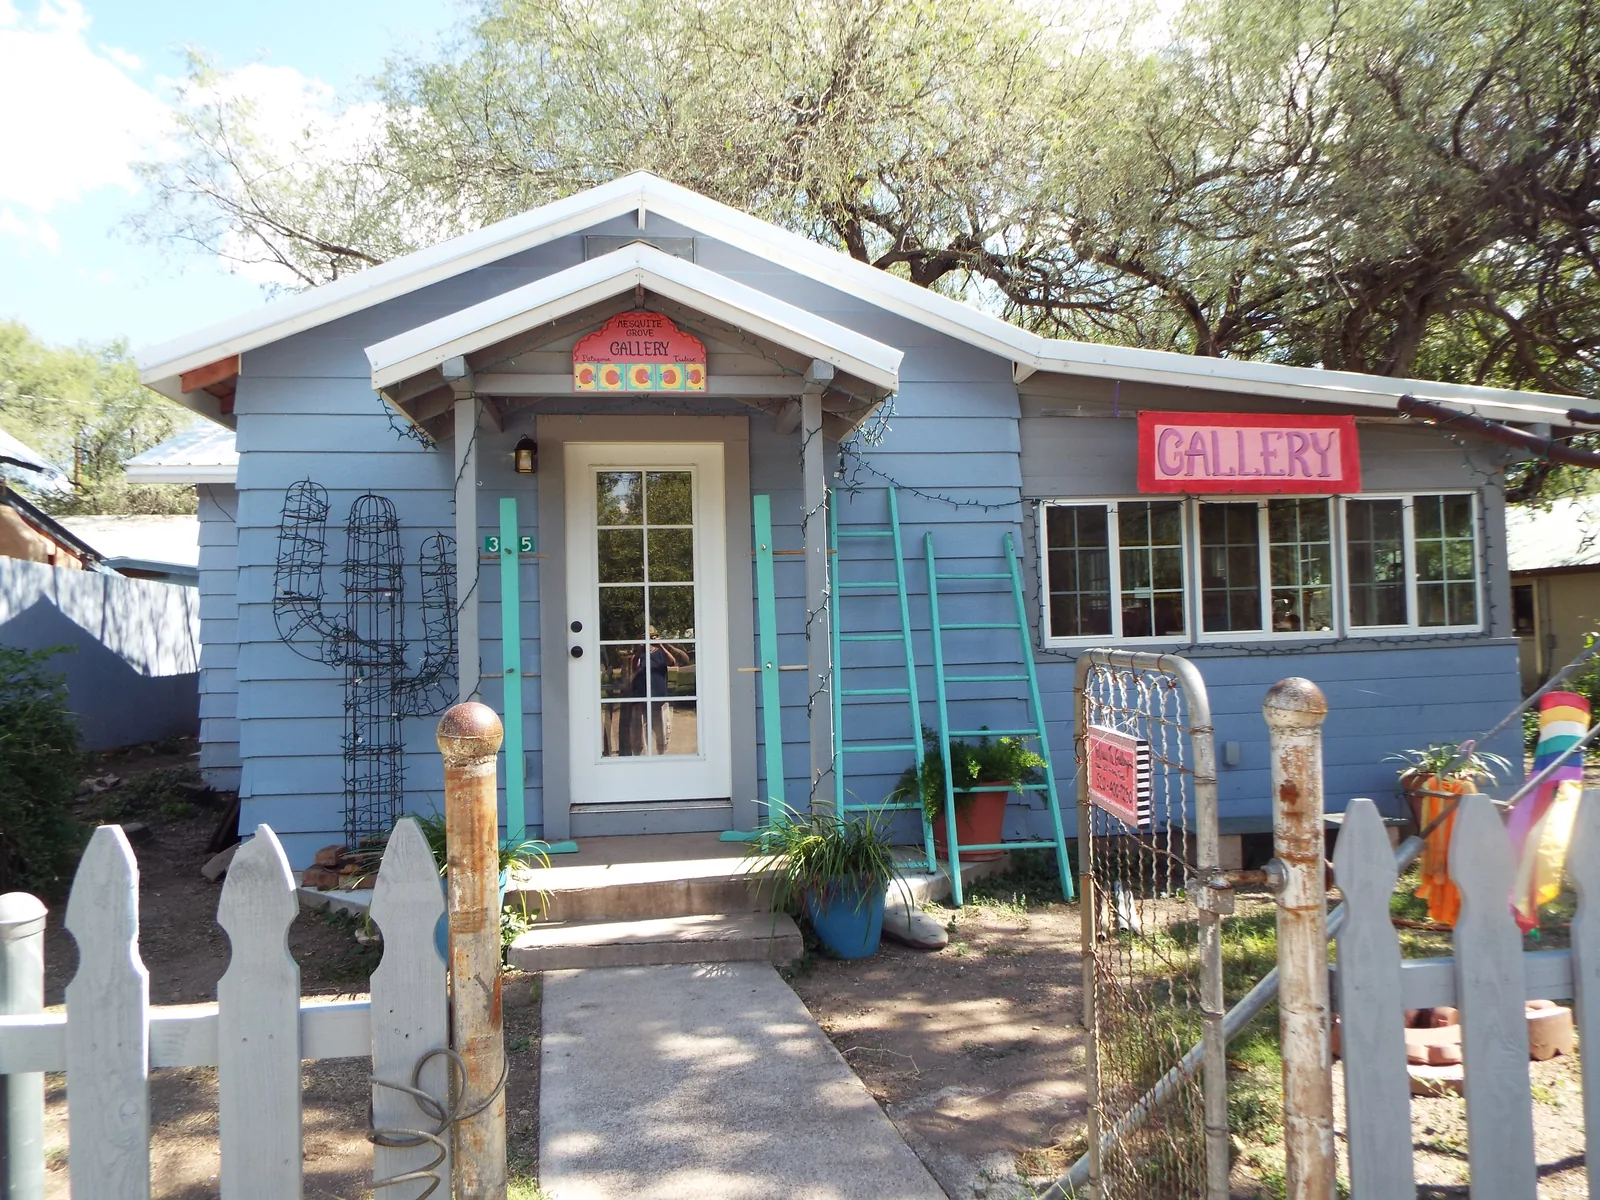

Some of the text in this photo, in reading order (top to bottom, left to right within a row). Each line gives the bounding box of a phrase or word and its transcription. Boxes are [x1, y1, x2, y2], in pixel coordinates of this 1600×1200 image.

[617, 319, 662, 328] MESQUITE
[626, 328, 654, 337] GROVE
[610, 341, 670, 356] GALLERY
[1157, 427, 1336, 478] GALLERY
